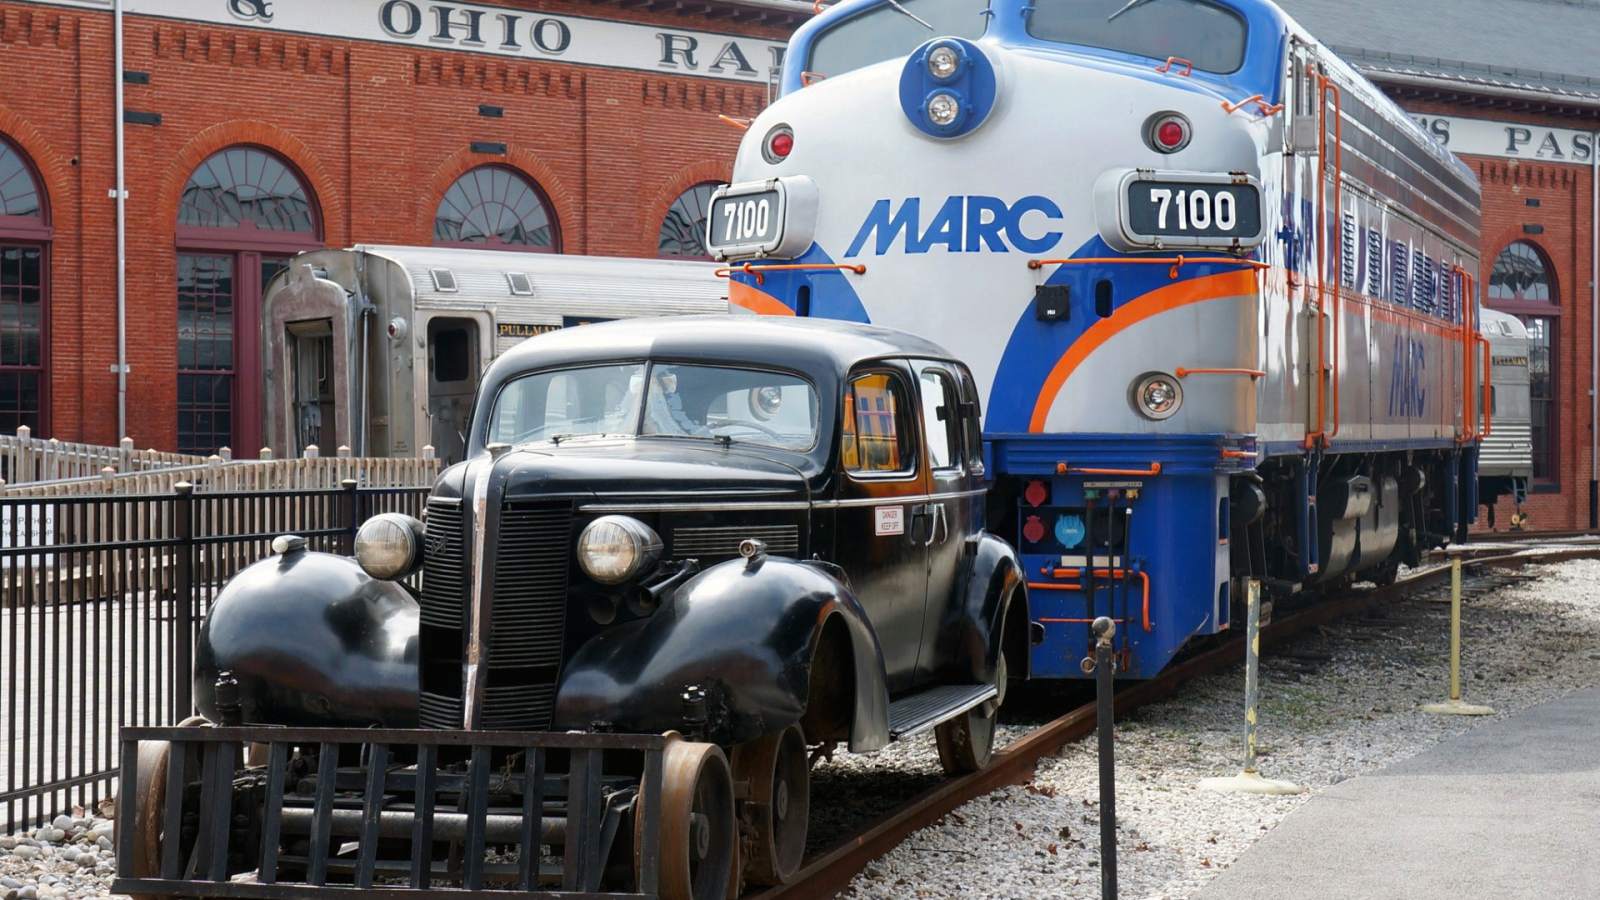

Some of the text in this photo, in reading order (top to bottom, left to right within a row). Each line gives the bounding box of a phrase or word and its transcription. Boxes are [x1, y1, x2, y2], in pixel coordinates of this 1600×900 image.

[227, 0, 273, 23] &
[378, 0, 571, 55] OHIO
[1504, 127, 1600, 161] PAS
[724, 199, 770, 241] 7100
[843, 195, 1064, 258] MARC
[1150, 188, 1236, 231] 7100
[1388, 334, 1426, 418] MARC
